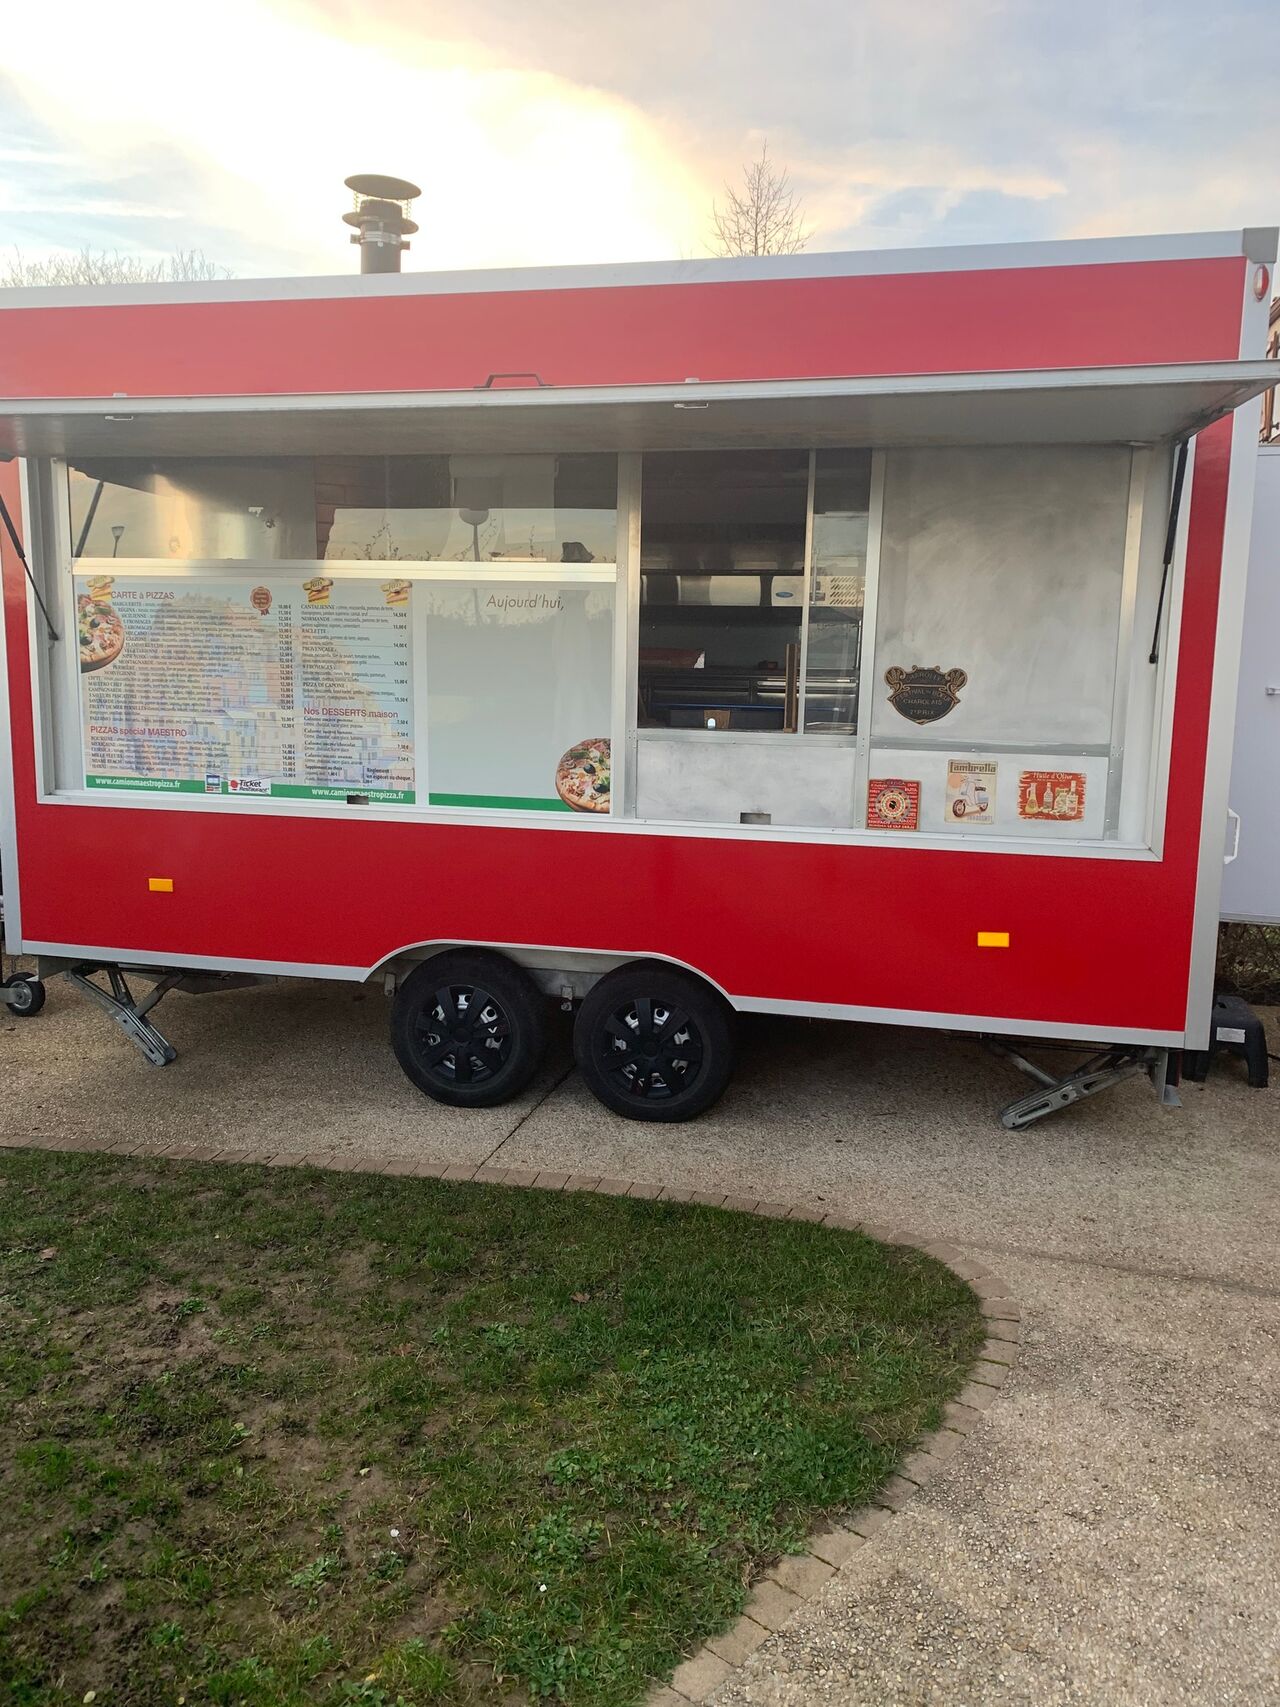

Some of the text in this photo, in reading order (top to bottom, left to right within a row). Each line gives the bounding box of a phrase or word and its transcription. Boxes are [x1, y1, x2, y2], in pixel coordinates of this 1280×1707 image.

[111, 592, 137, 600] CARTE
[146, 592, 175, 600] PIZZAS
[486, 594, 564, 612] Aujourd'hui,
[322, 708, 367, 717] DESSERTS
[90, 726, 118, 734] PIZZAS
[148, 728, 187, 737] MAESTRO
[95, 778, 181, 789] www.camionmaestropizza.fr
